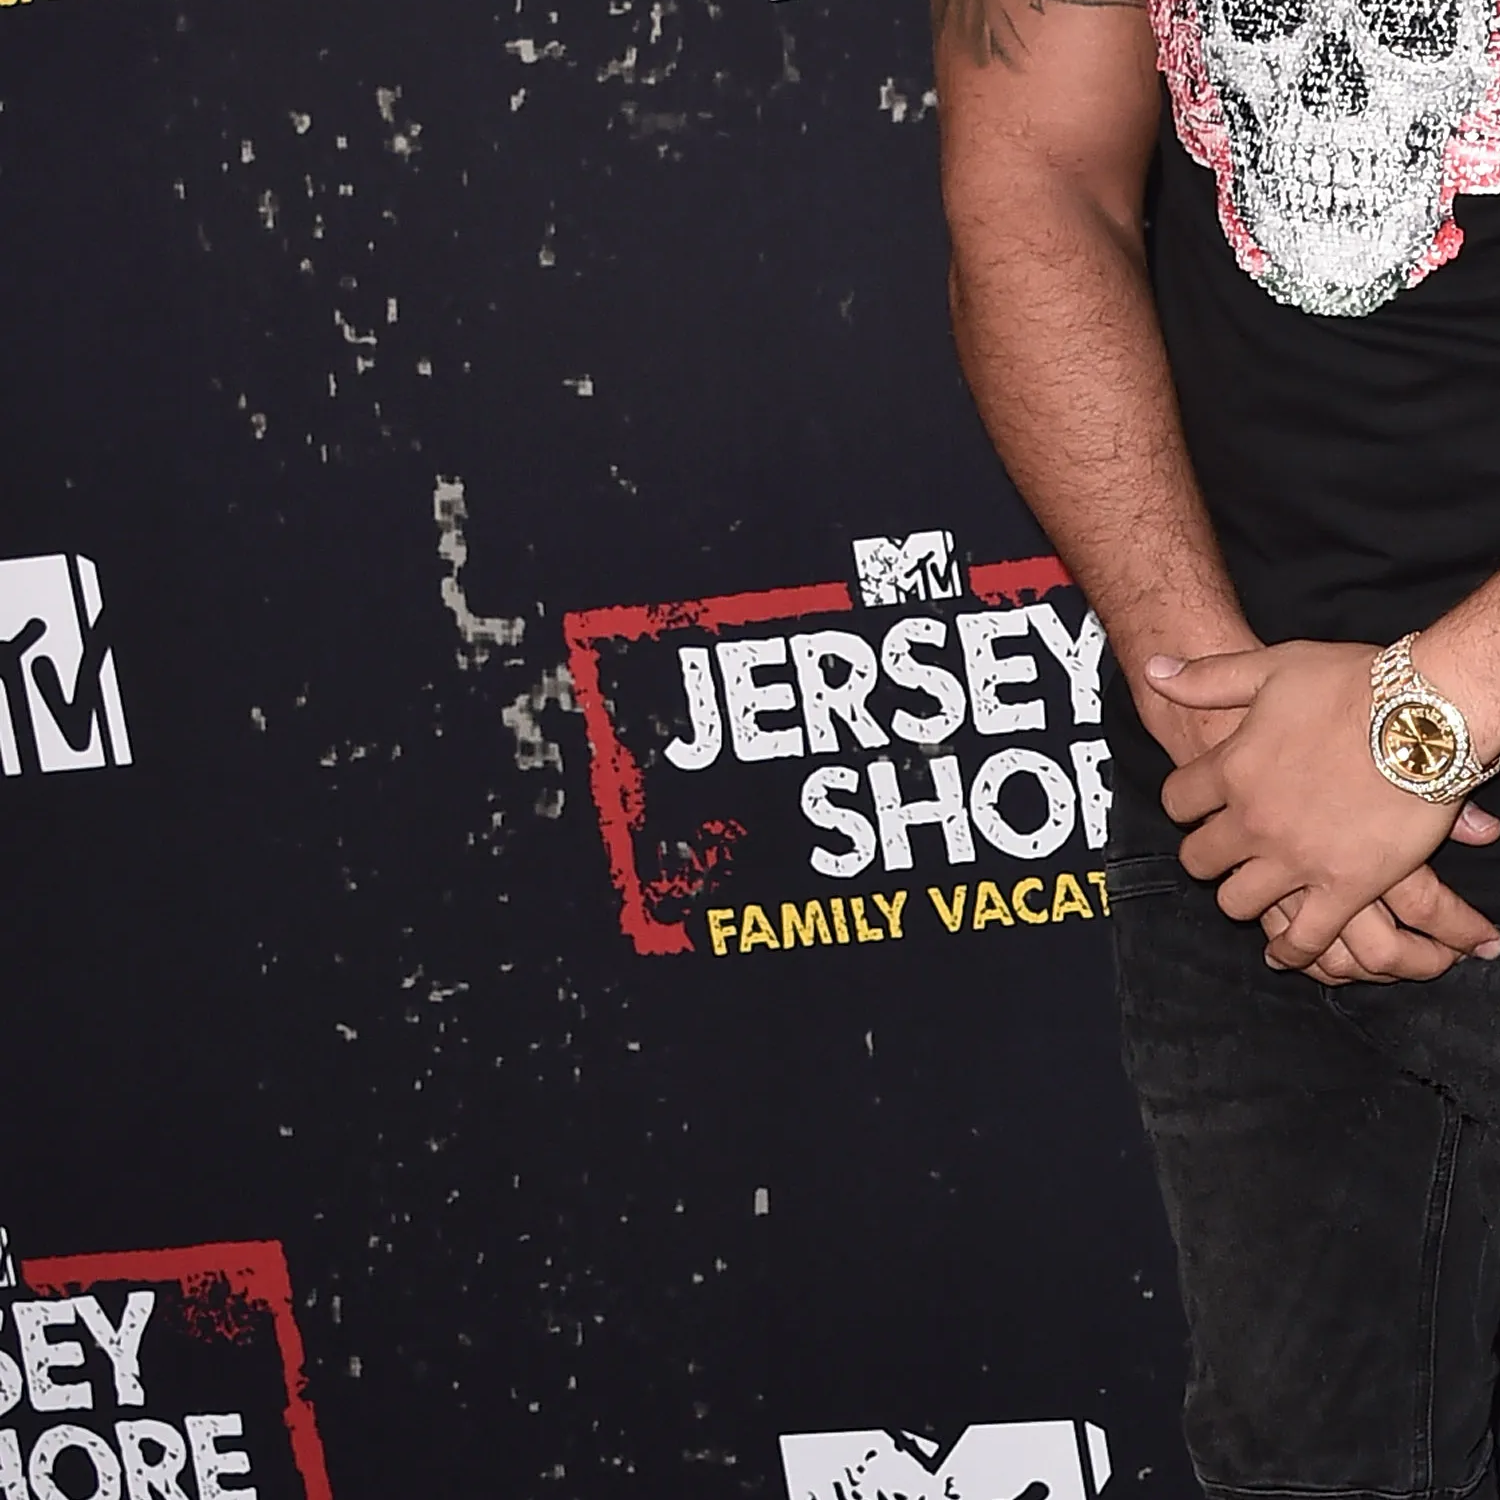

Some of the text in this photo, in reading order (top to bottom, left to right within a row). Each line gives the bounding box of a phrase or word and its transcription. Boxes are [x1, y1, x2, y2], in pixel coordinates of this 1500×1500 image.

[851, 531, 963, 607] MTV
[663, 603, 1107, 771] JERSEY
[801, 739, 1113, 878] SHO
[706, 871, 1111, 956] FAMILY VACAT
